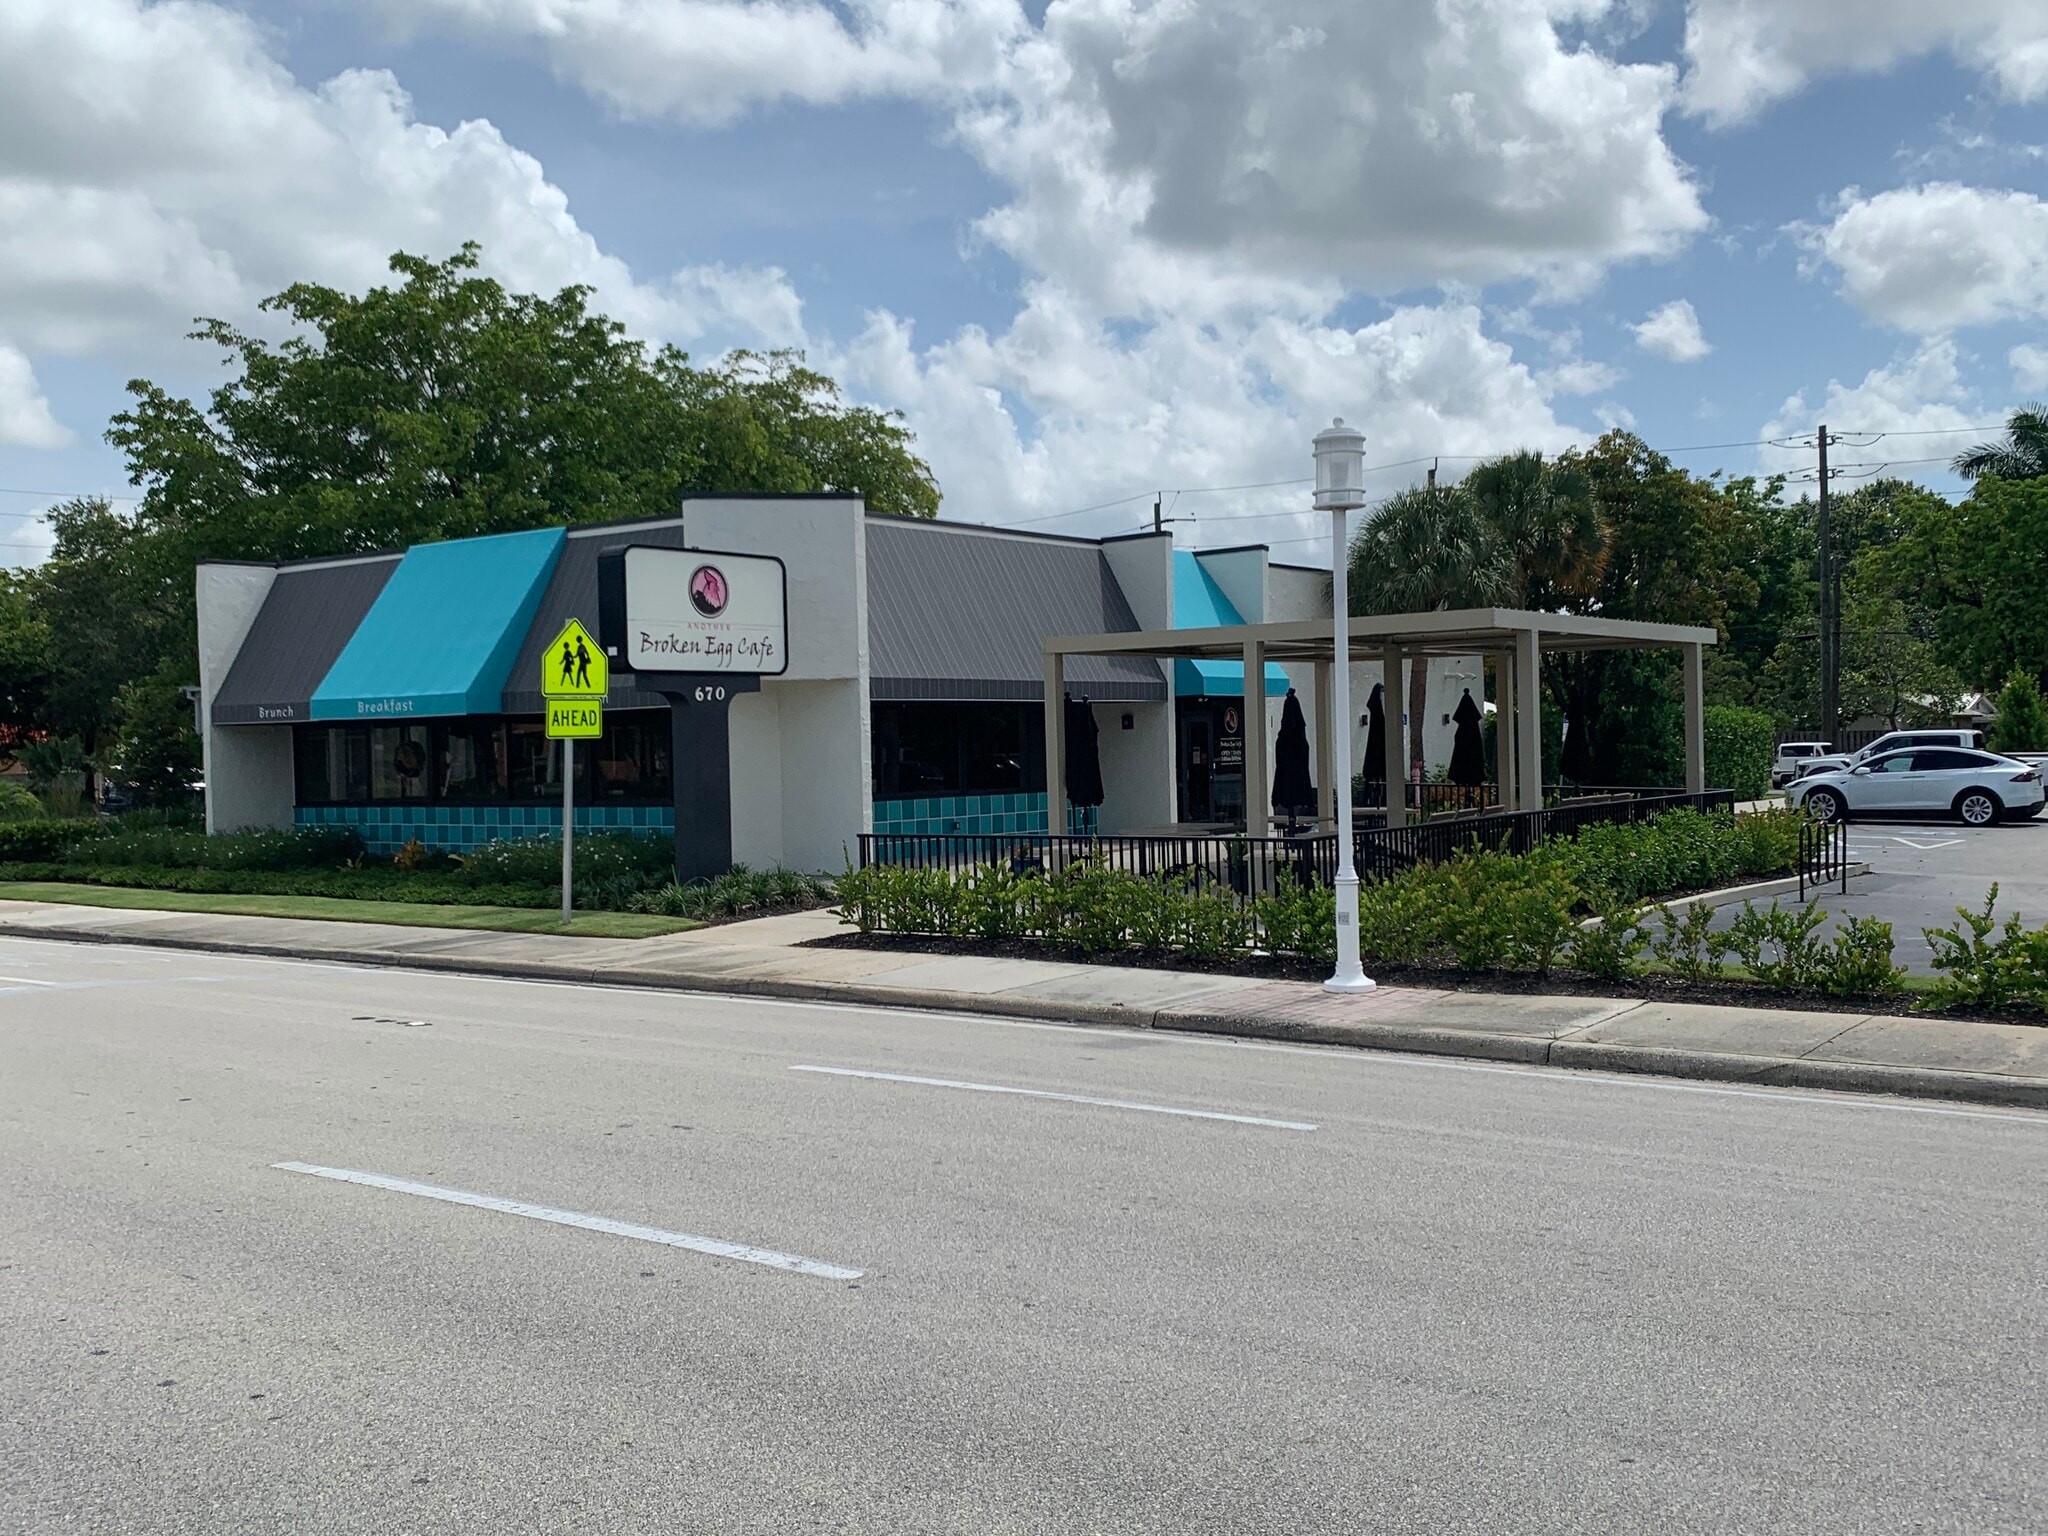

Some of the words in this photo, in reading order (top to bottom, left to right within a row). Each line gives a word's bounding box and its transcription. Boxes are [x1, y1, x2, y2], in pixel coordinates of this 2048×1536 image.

[687, 622, 731, 631] ANOTHER
[639, 631, 702, 654] Broken
[704, 635, 733, 669] Egg
[737, 635, 774, 669] Cafe
[694, 685, 726, 702] 670
[258, 705, 294, 719] Brunch
[357, 699, 414, 714] Breakfast
[551, 709, 598, 727] AHEAD
